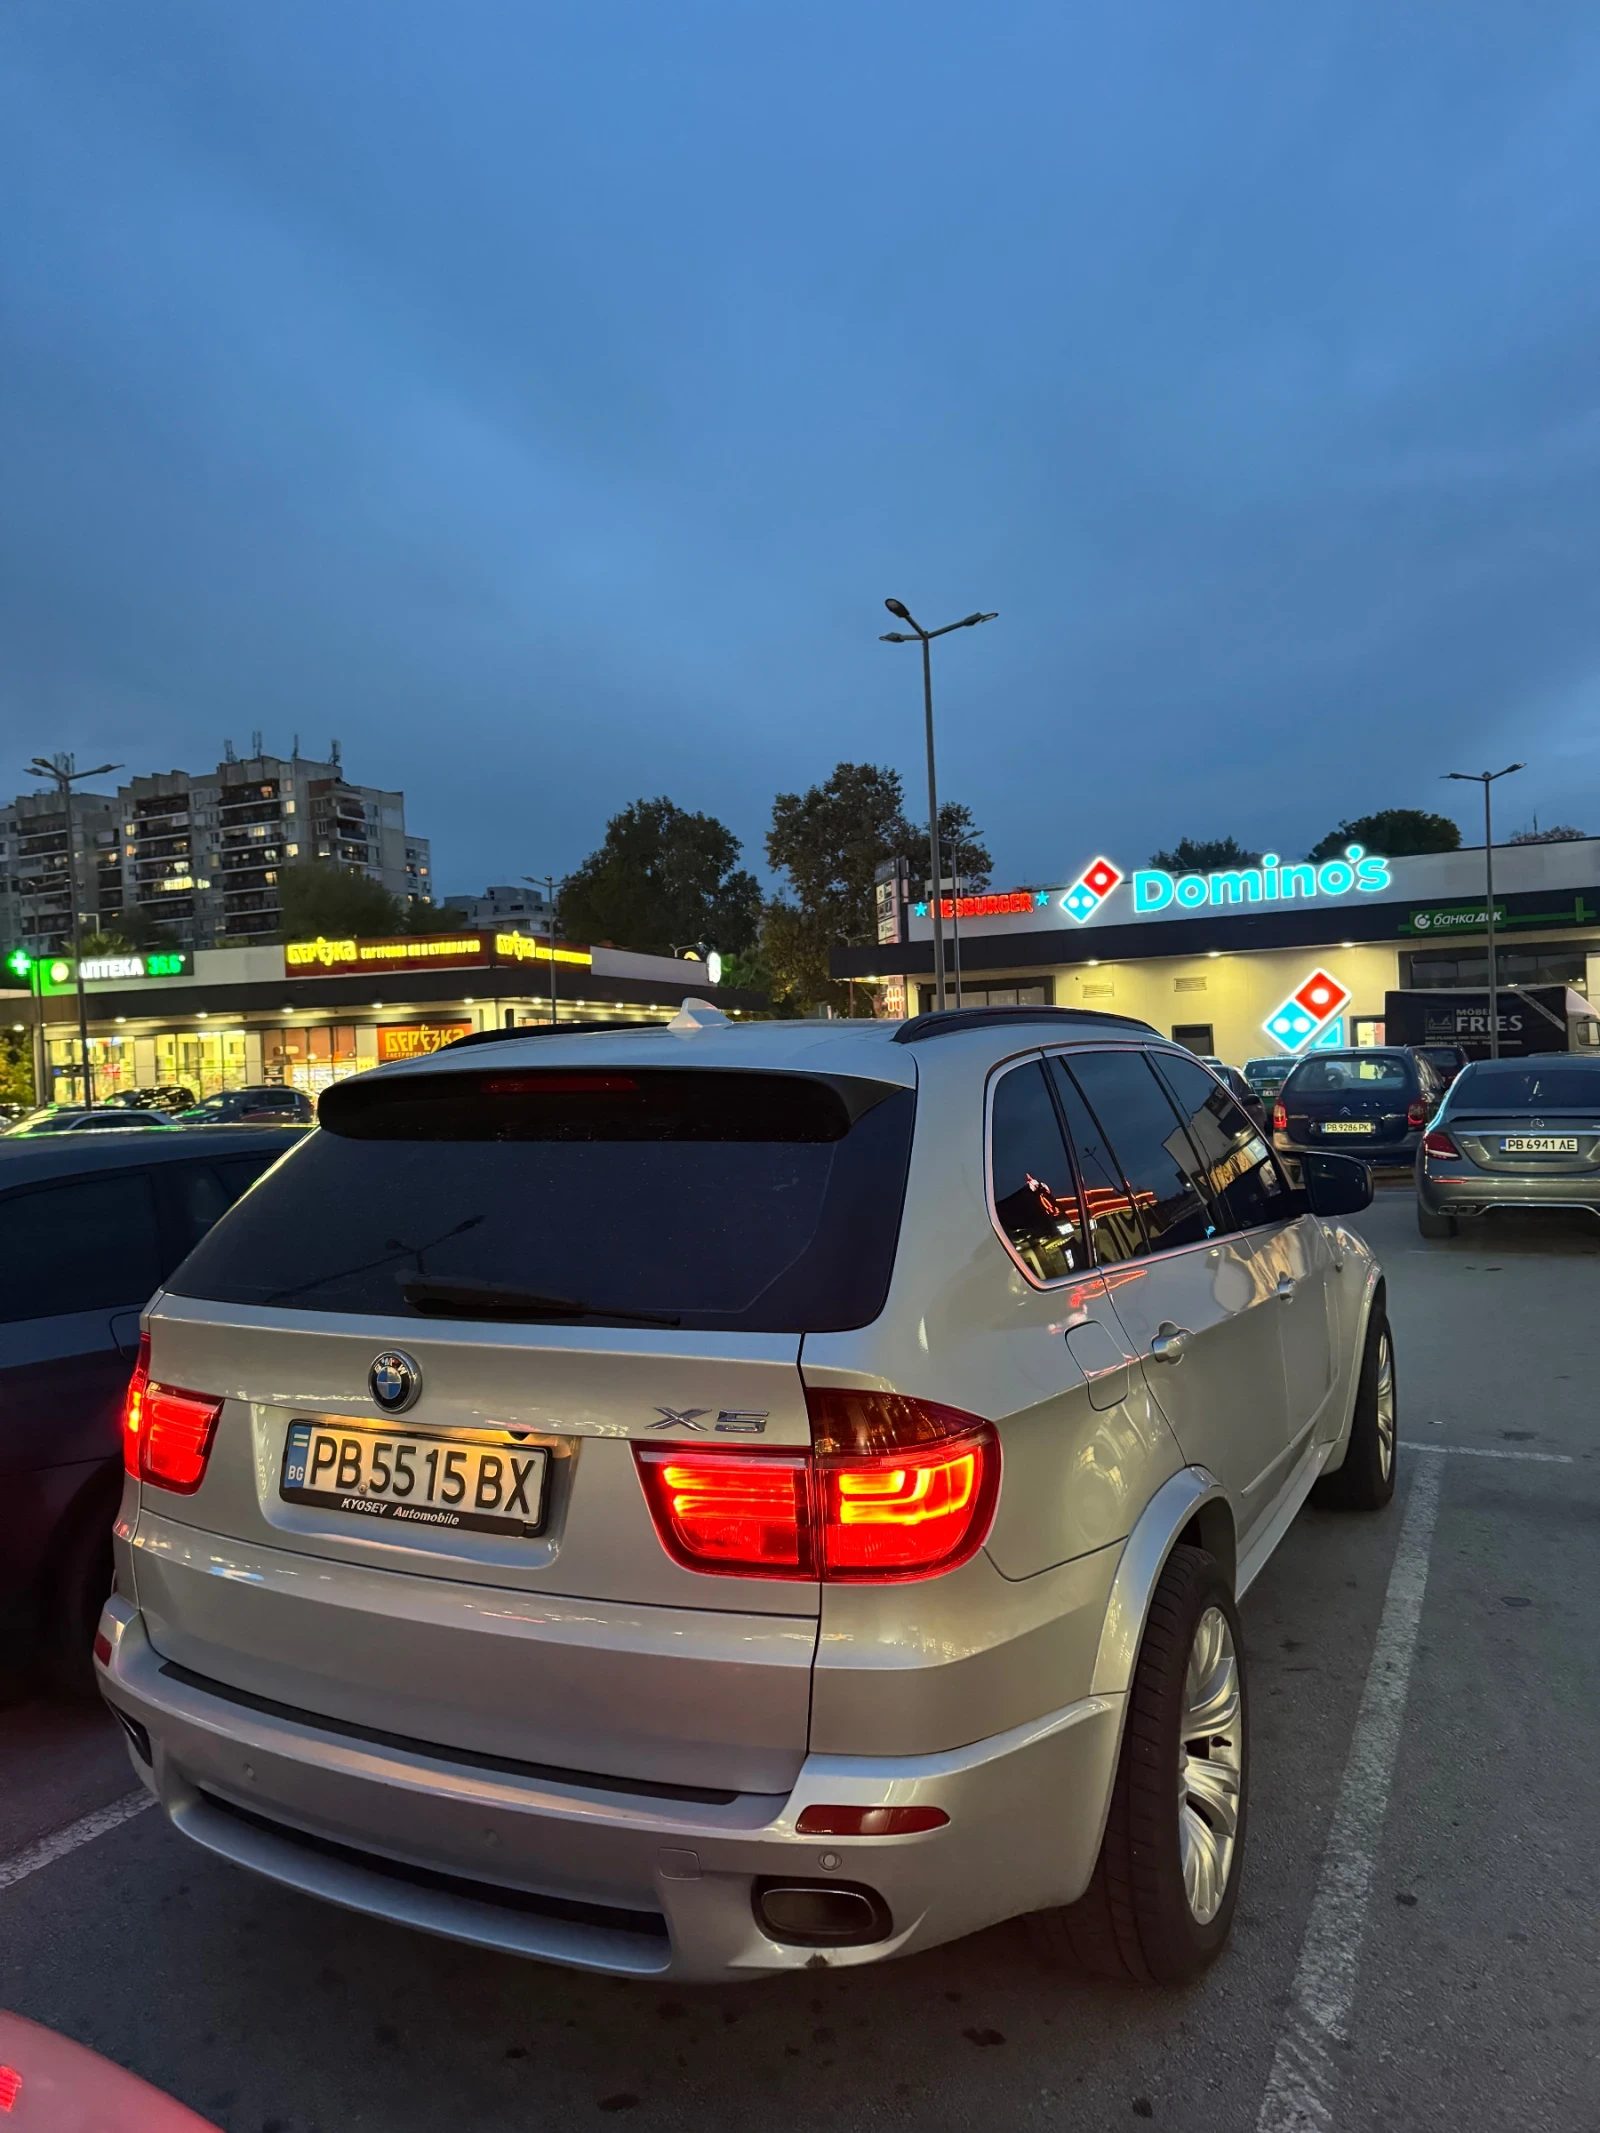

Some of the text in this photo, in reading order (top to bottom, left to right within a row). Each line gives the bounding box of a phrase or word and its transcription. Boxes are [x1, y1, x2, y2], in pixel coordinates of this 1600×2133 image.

[1132, 844, 1391, 913] Domino's
[1433, 913, 1475, 926] банка
[1456, 1014, 1523, 1032] FRIES
[1508, 1139, 1575, 1150] PB 6941 AE
[644, 1406, 769, 1434] X5
[287, 1465, 304, 1482] BG
[310, 1435, 535, 1514] PB 5515 BX
[341, 1497, 460, 1526] KYOSEV Automobile
